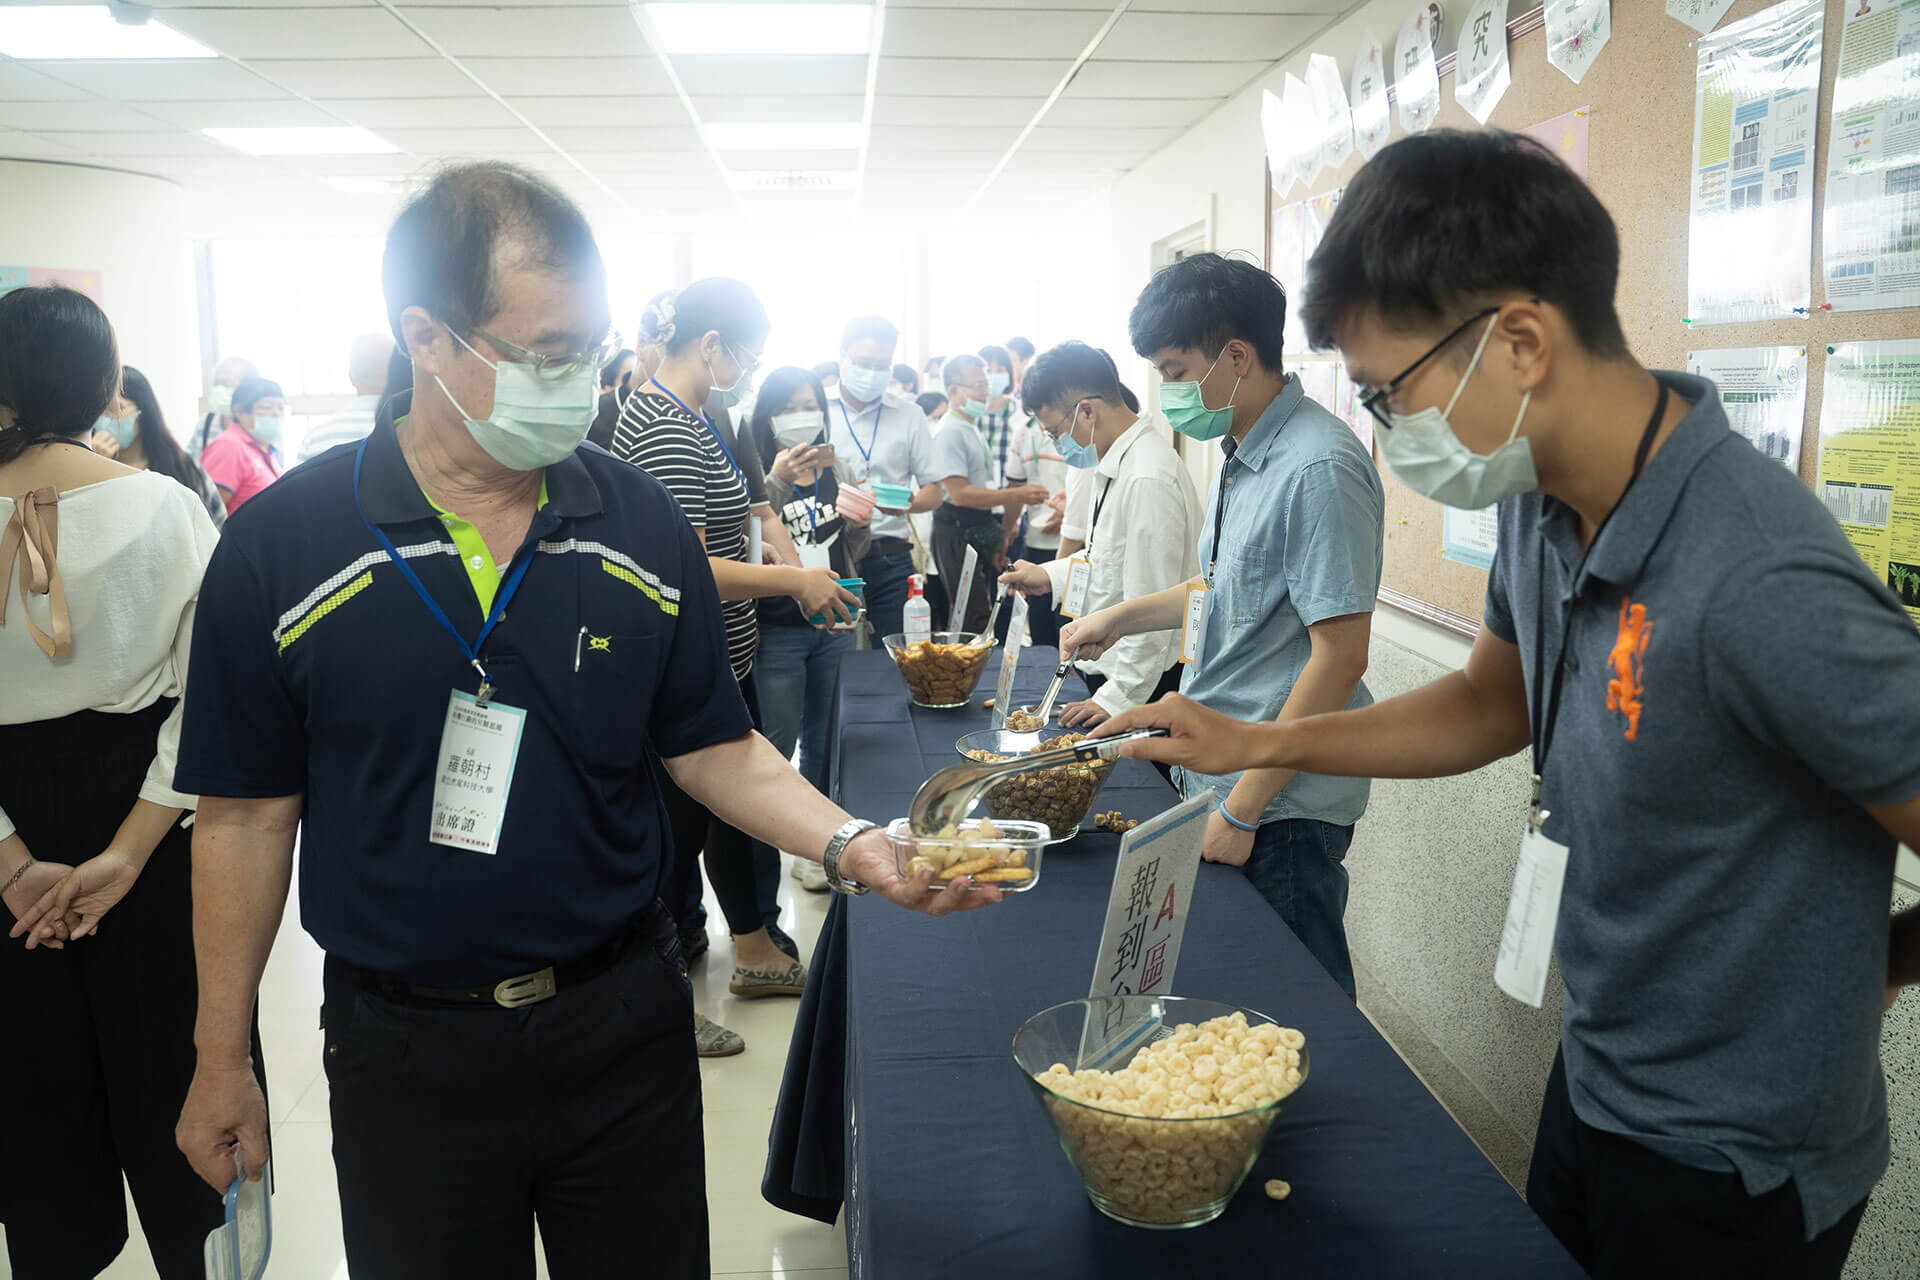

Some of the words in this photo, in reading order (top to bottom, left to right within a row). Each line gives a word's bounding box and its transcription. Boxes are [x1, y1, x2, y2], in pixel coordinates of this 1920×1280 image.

[1472, 10, 1491, 61] 究
[782, 495, 823, 522] ERY.
[784, 503, 840, 537] NGLE.
[447, 754, 491, 781] 羅朝村
[435, 810, 477, 833] 出席證
